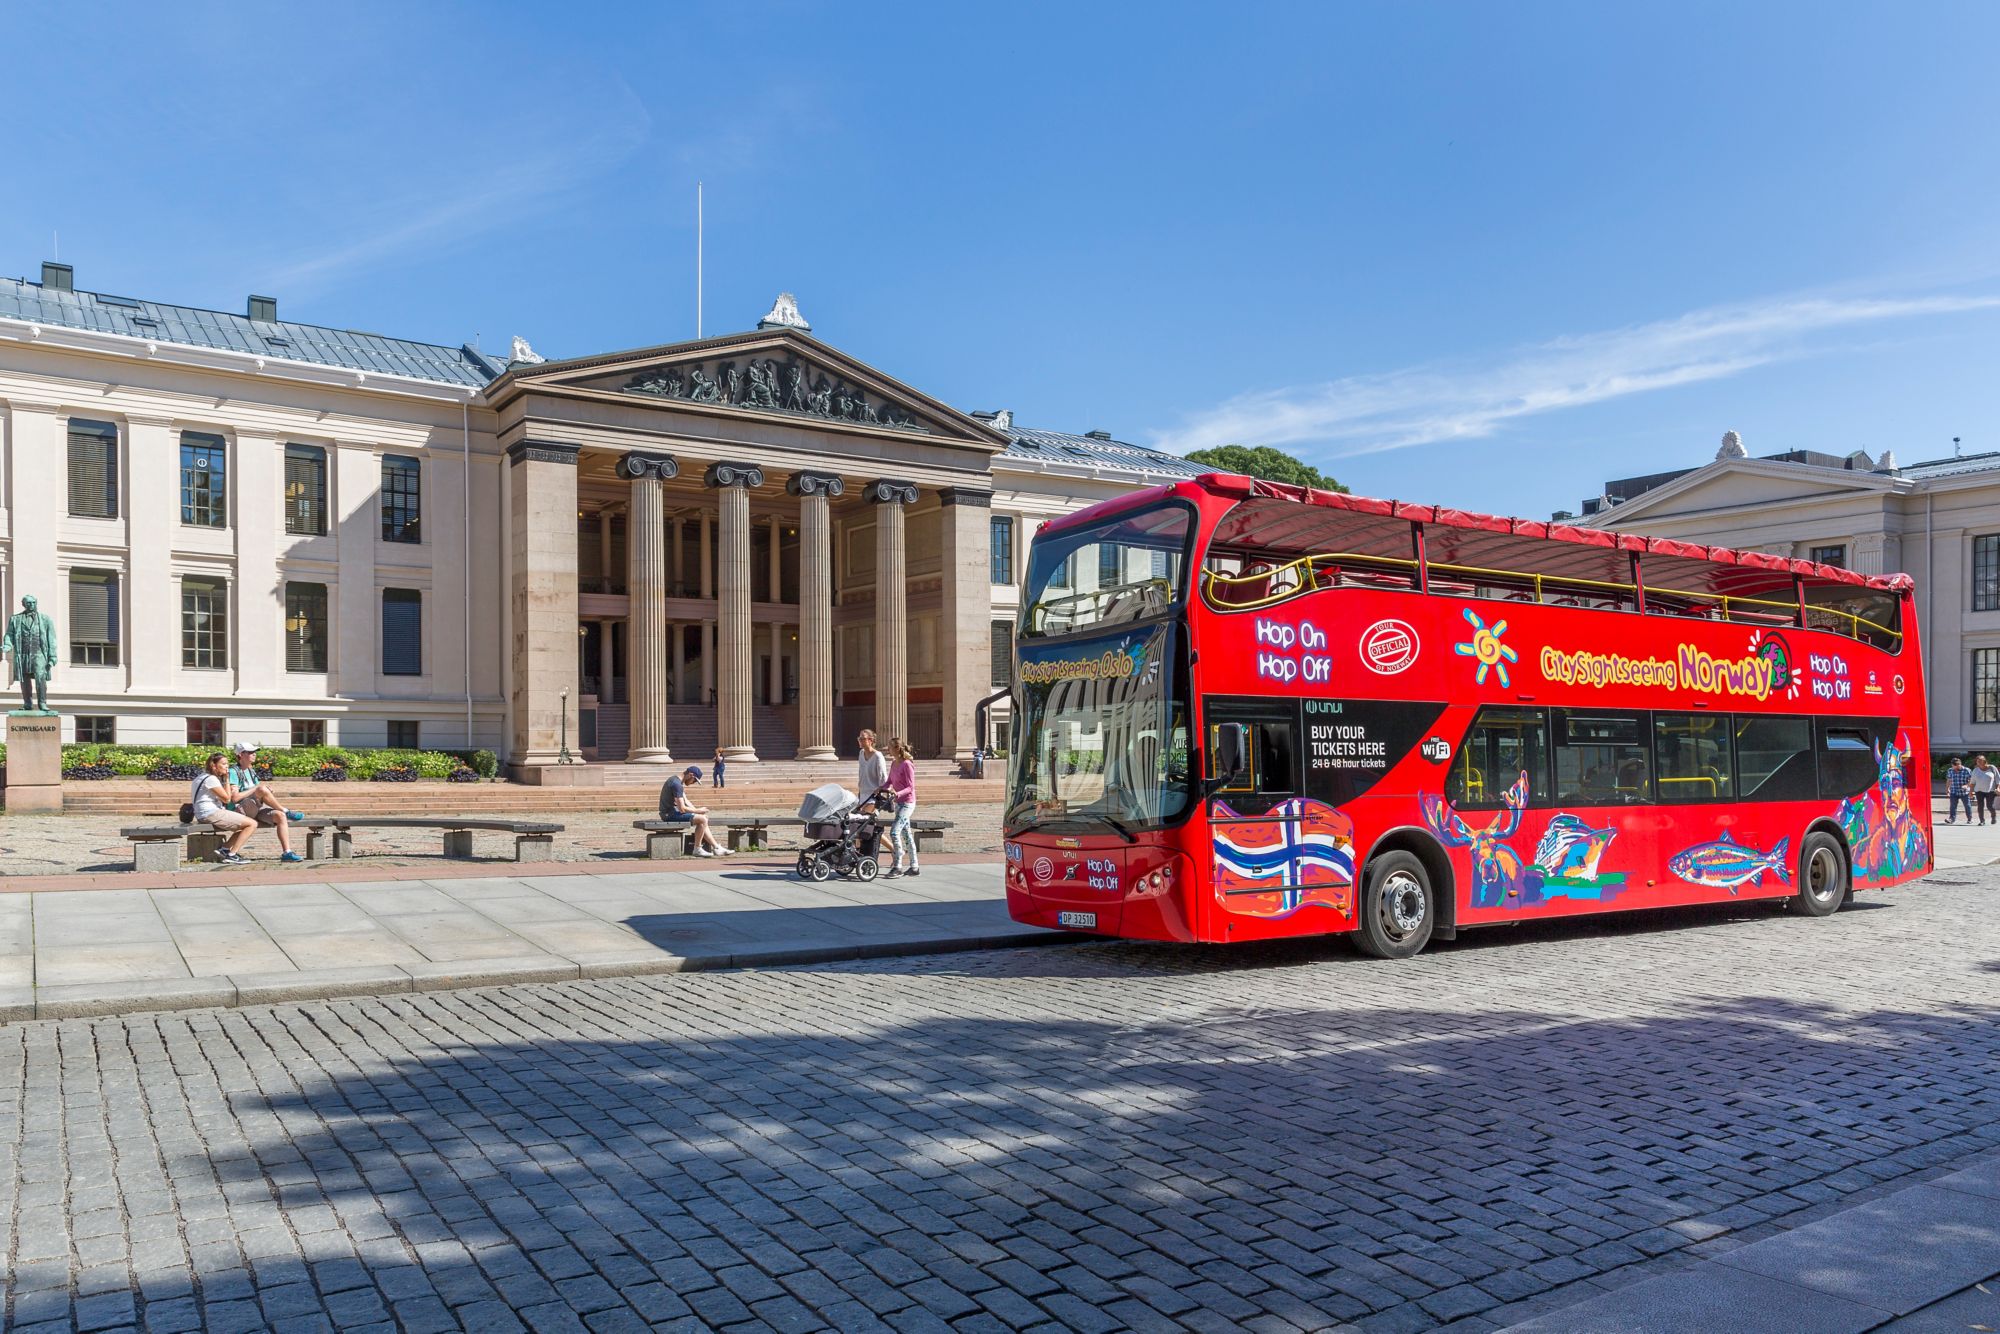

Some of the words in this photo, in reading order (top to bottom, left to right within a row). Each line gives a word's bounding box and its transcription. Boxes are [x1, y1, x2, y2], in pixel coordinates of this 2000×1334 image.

[1256, 618, 1296, 649] Hop
[1300, 621, 1326, 649] On
[1374, 622, 1395, 632] TOUR
[1371, 638, 1409, 656] OFFICIAL
[1101, 651, 1134, 679] Oslo
[1258, 652, 1298, 683] Hop
[1301, 654, 1332, 682] Off
[1386, 655, 1412, 672] NORWAY
[1678, 643, 1771, 701] Norway
[1809, 653, 1832, 676] Hop
[1832, 655, 1848, 675] On
[1811, 678, 1834, 700] Hop
[1834, 679, 1851, 699] Off
[1311, 726, 1334, 739] BUY
[1335, 726, 1365, 739] YOUR
[1311, 742, 1356, 755] TICKETS
[1358, 742, 1386, 755] HERE
[1312, 759, 1322, 769] 24
[1331, 759, 1342, 769] 48
[1342, 758, 1360, 768] hour
[1360, 758, 1386, 768] tickets
[1087, 859, 1103, 873] Hop
[1104, 859, 1116, 872] On
[1089, 876, 1105, 890] Hop
[1106, 876, 1119, 889] Off
[1063, 914, 1072, 922] DP
[1074, 914, 1094, 925] 32510
